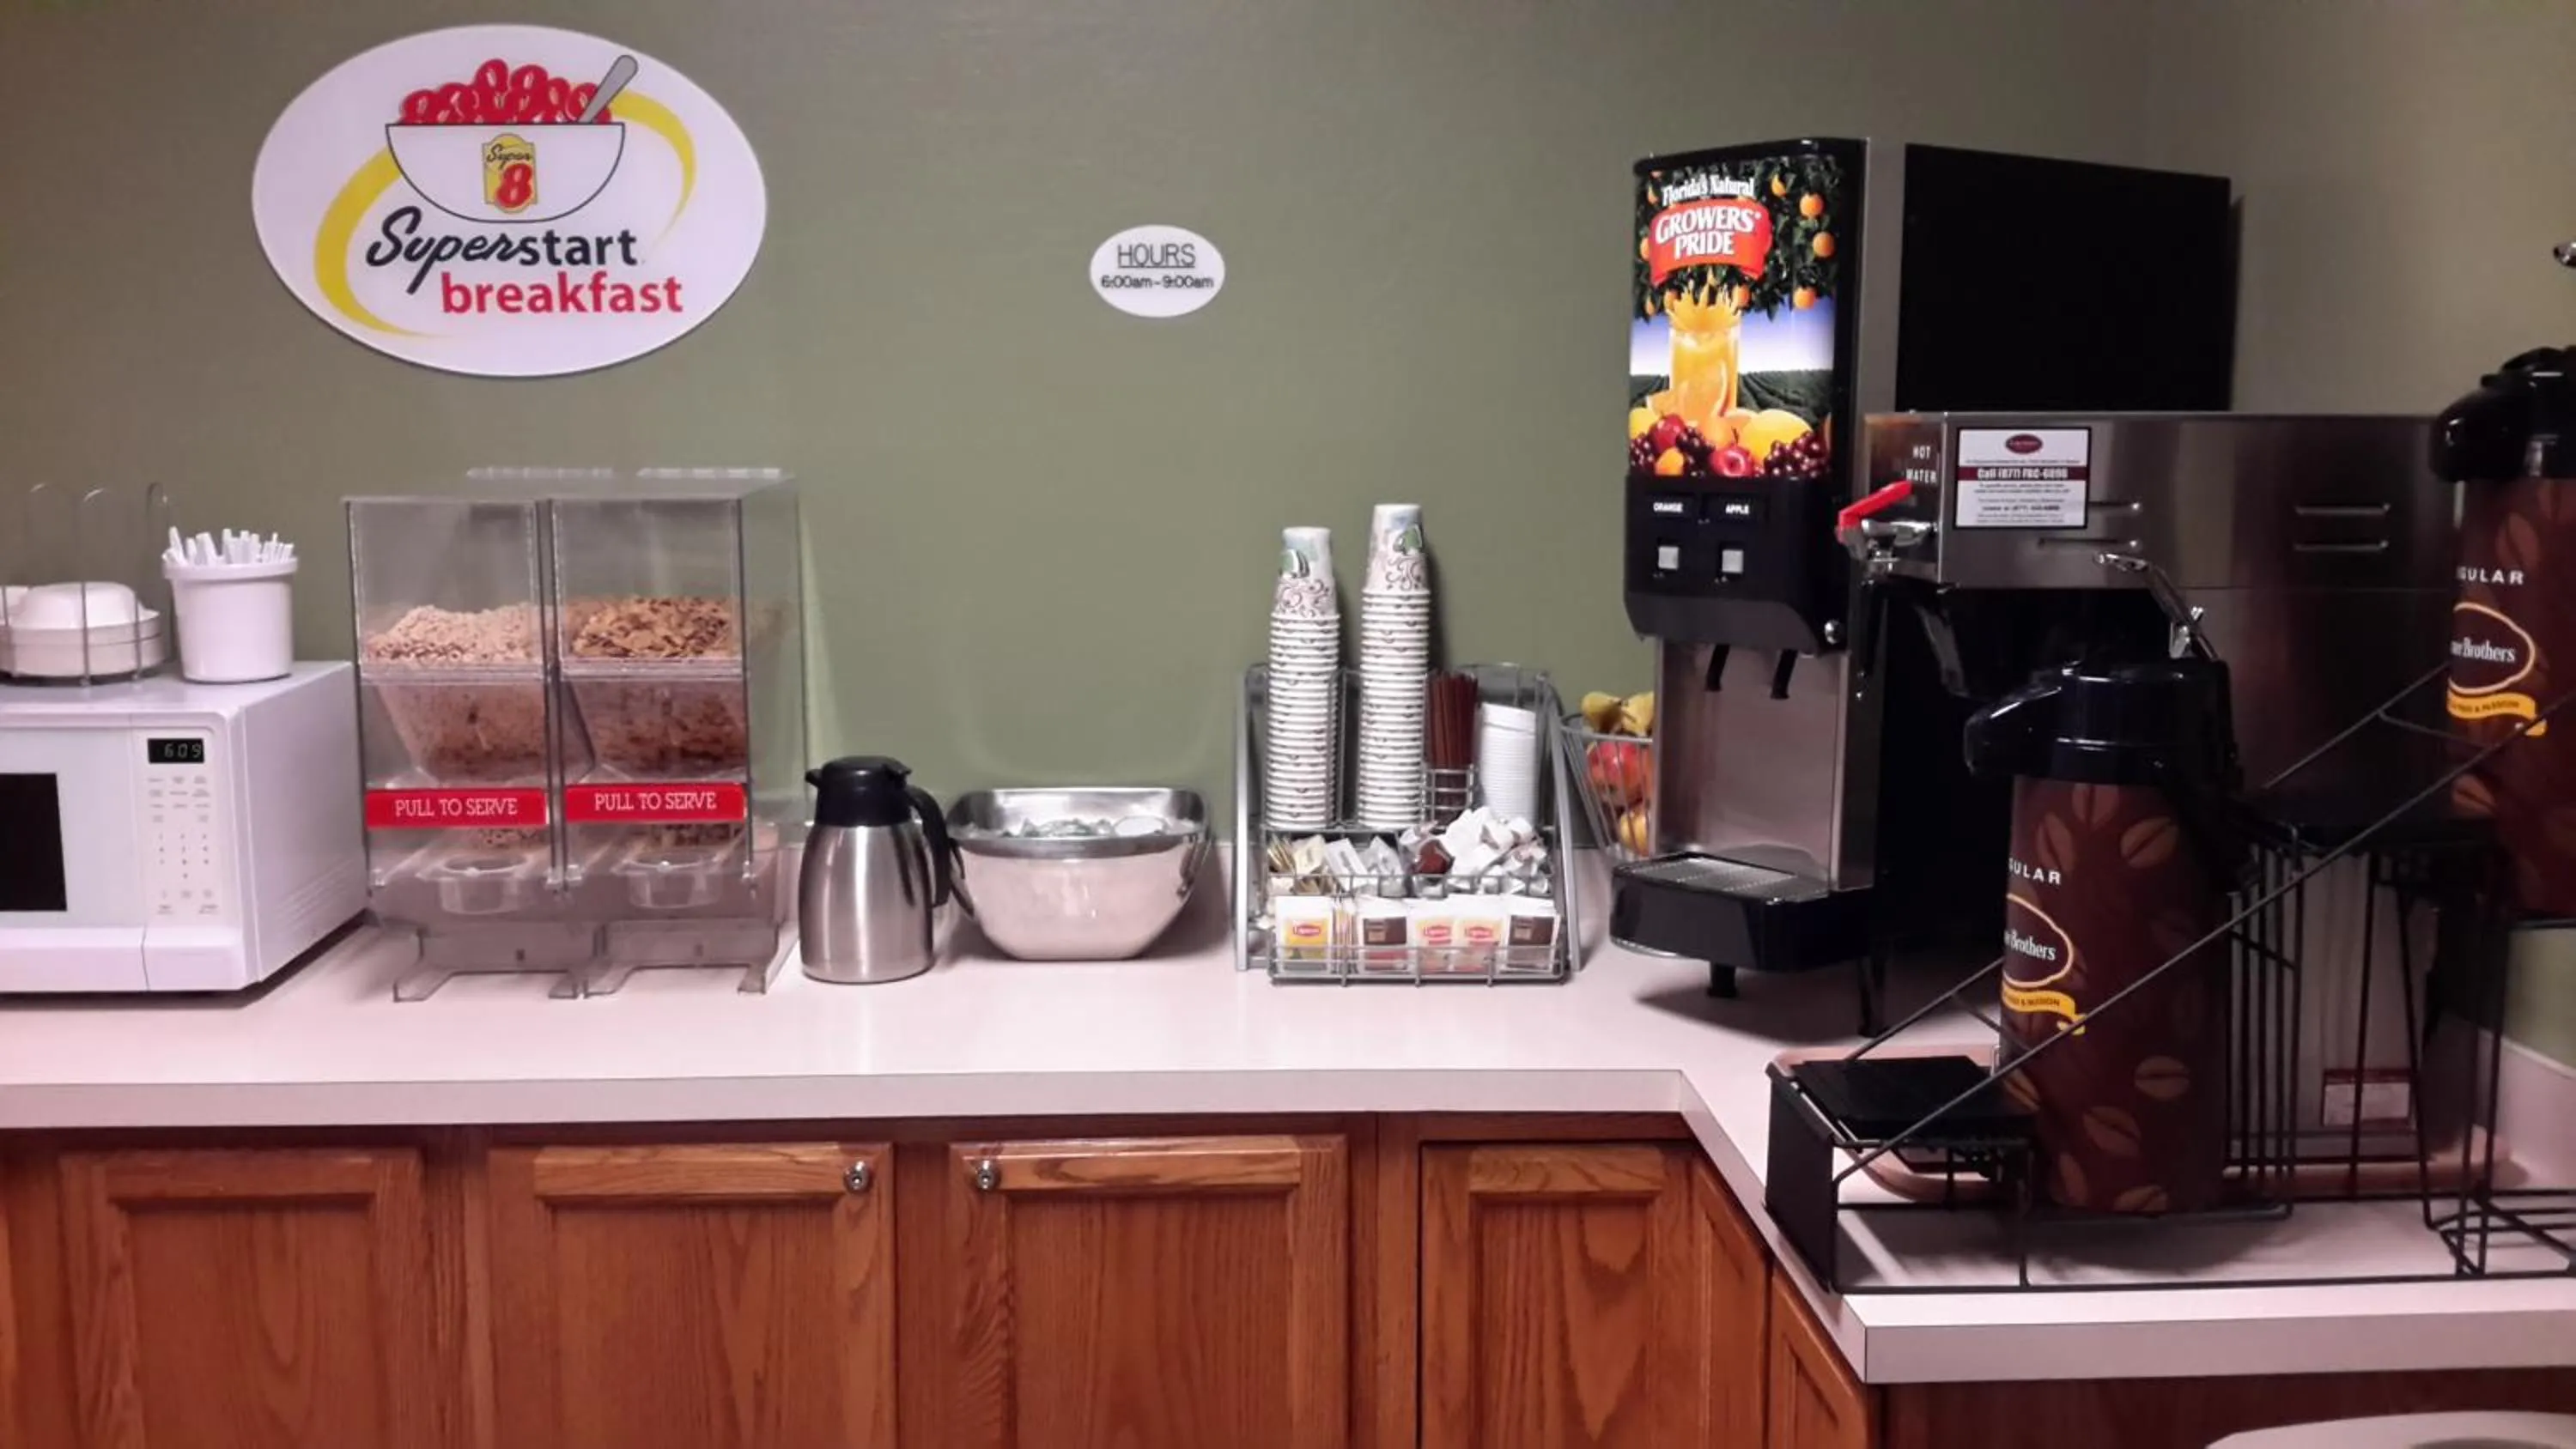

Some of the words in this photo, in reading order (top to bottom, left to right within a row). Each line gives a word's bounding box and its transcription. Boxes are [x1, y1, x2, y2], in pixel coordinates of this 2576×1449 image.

[495, 162, 533, 209] 8
[1662, 173, 1708, 207] Florida's
[1709, 173, 1754, 198] Natural
[365, 205, 637, 294] Superstart
[1117, 243, 1196, 268] HOURS
[1675, 231, 1735, 260] PRIDE
[440, 270, 683, 314] breakfast
[1912, 445, 1931, 459] HOT
[1725, 504, 1749, 514] APPLE
[2463, 636, 2515, 663] Brothers
[395, 798, 435, 816] PULL
[438, 797, 463, 815] TO
[465, 797, 519, 815] SERVE
[594, 791, 635, 811] PULL
[637, 791, 662, 810] TO
[665, 791, 717, 810] SERVE
[2010, 929, 2057, 961] Brothers
